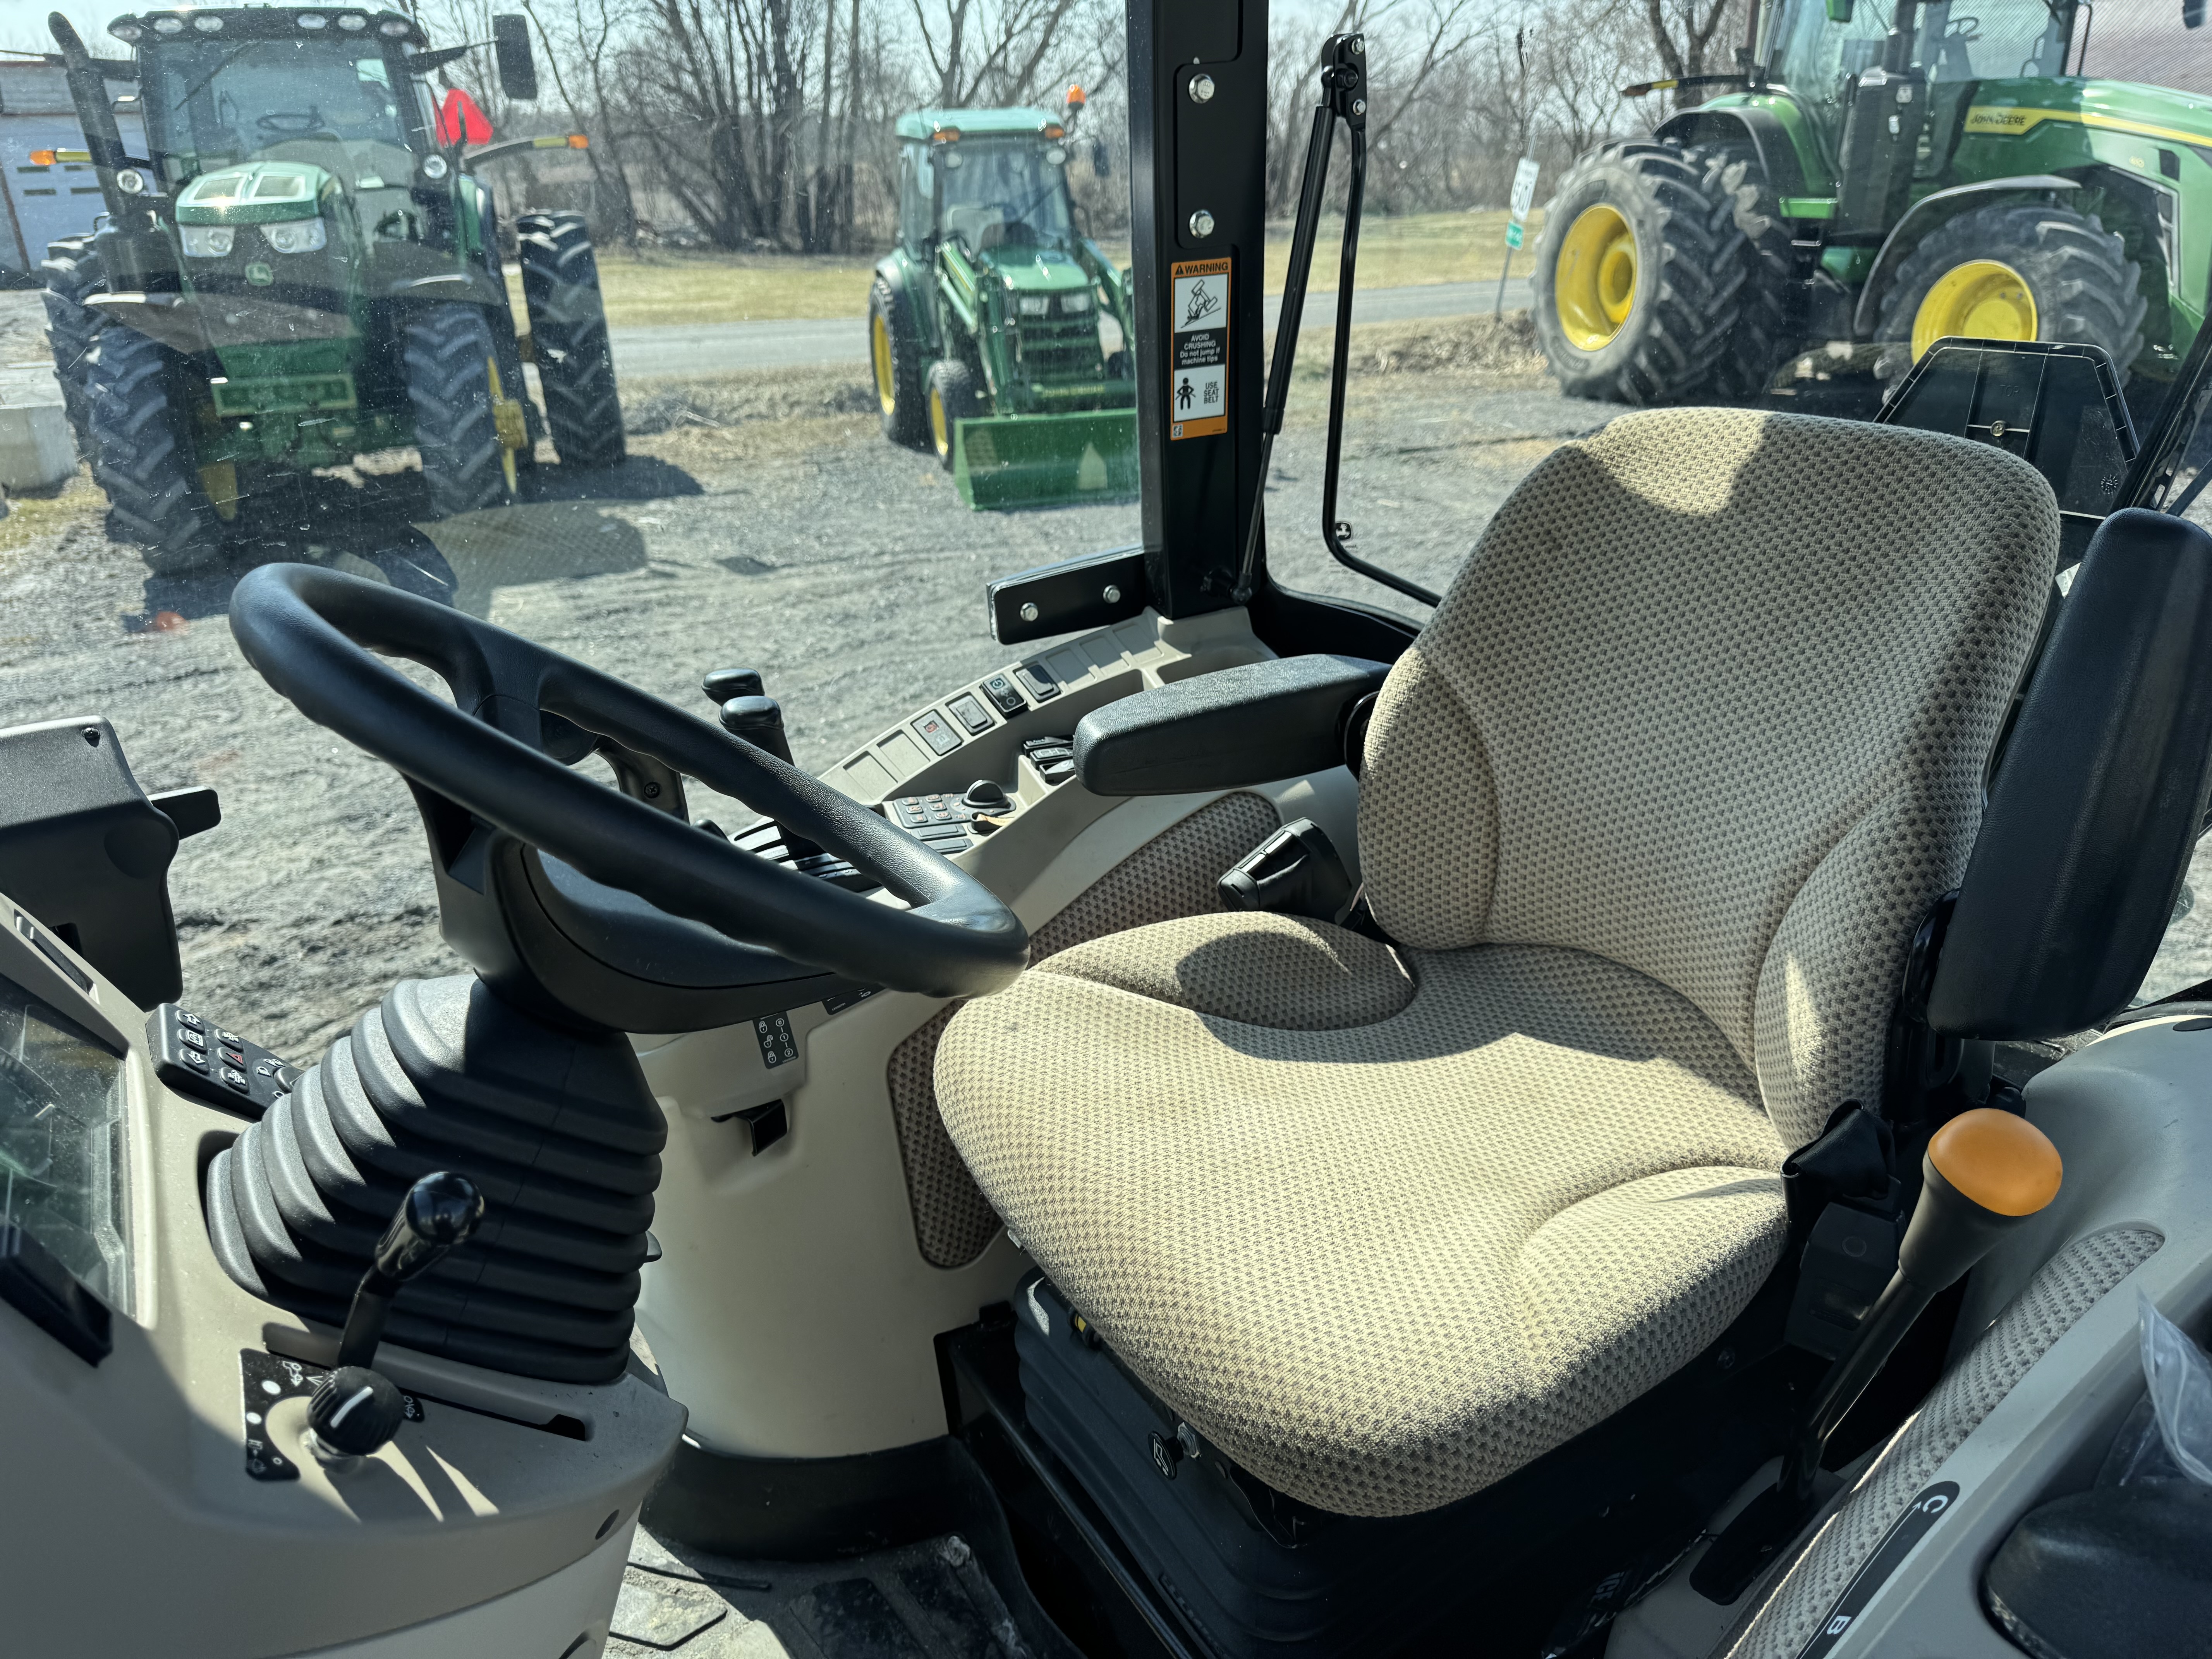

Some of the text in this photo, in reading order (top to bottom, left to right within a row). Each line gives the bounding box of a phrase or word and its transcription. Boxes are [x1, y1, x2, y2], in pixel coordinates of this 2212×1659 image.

[1996, 113, 2027, 125] DEERE
[1185, 262, 1228, 275] WARNING
[1191, 333, 1210, 342] AVOID
[1184, 340, 1216, 350] CRUSHING
[1200, 348, 1215, 357] jump
[1182, 355, 1218, 365] machine tips
[1205, 381, 1218, 390] USE
[1204, 388, 1219, 397] SEAT
[2000, 385, 2020, 397] TOP
[1204, 396, 1219, 404] BELT
[1922, 1495, 1948, 1513] C
[1827, 1615, 1851, 1635] B
